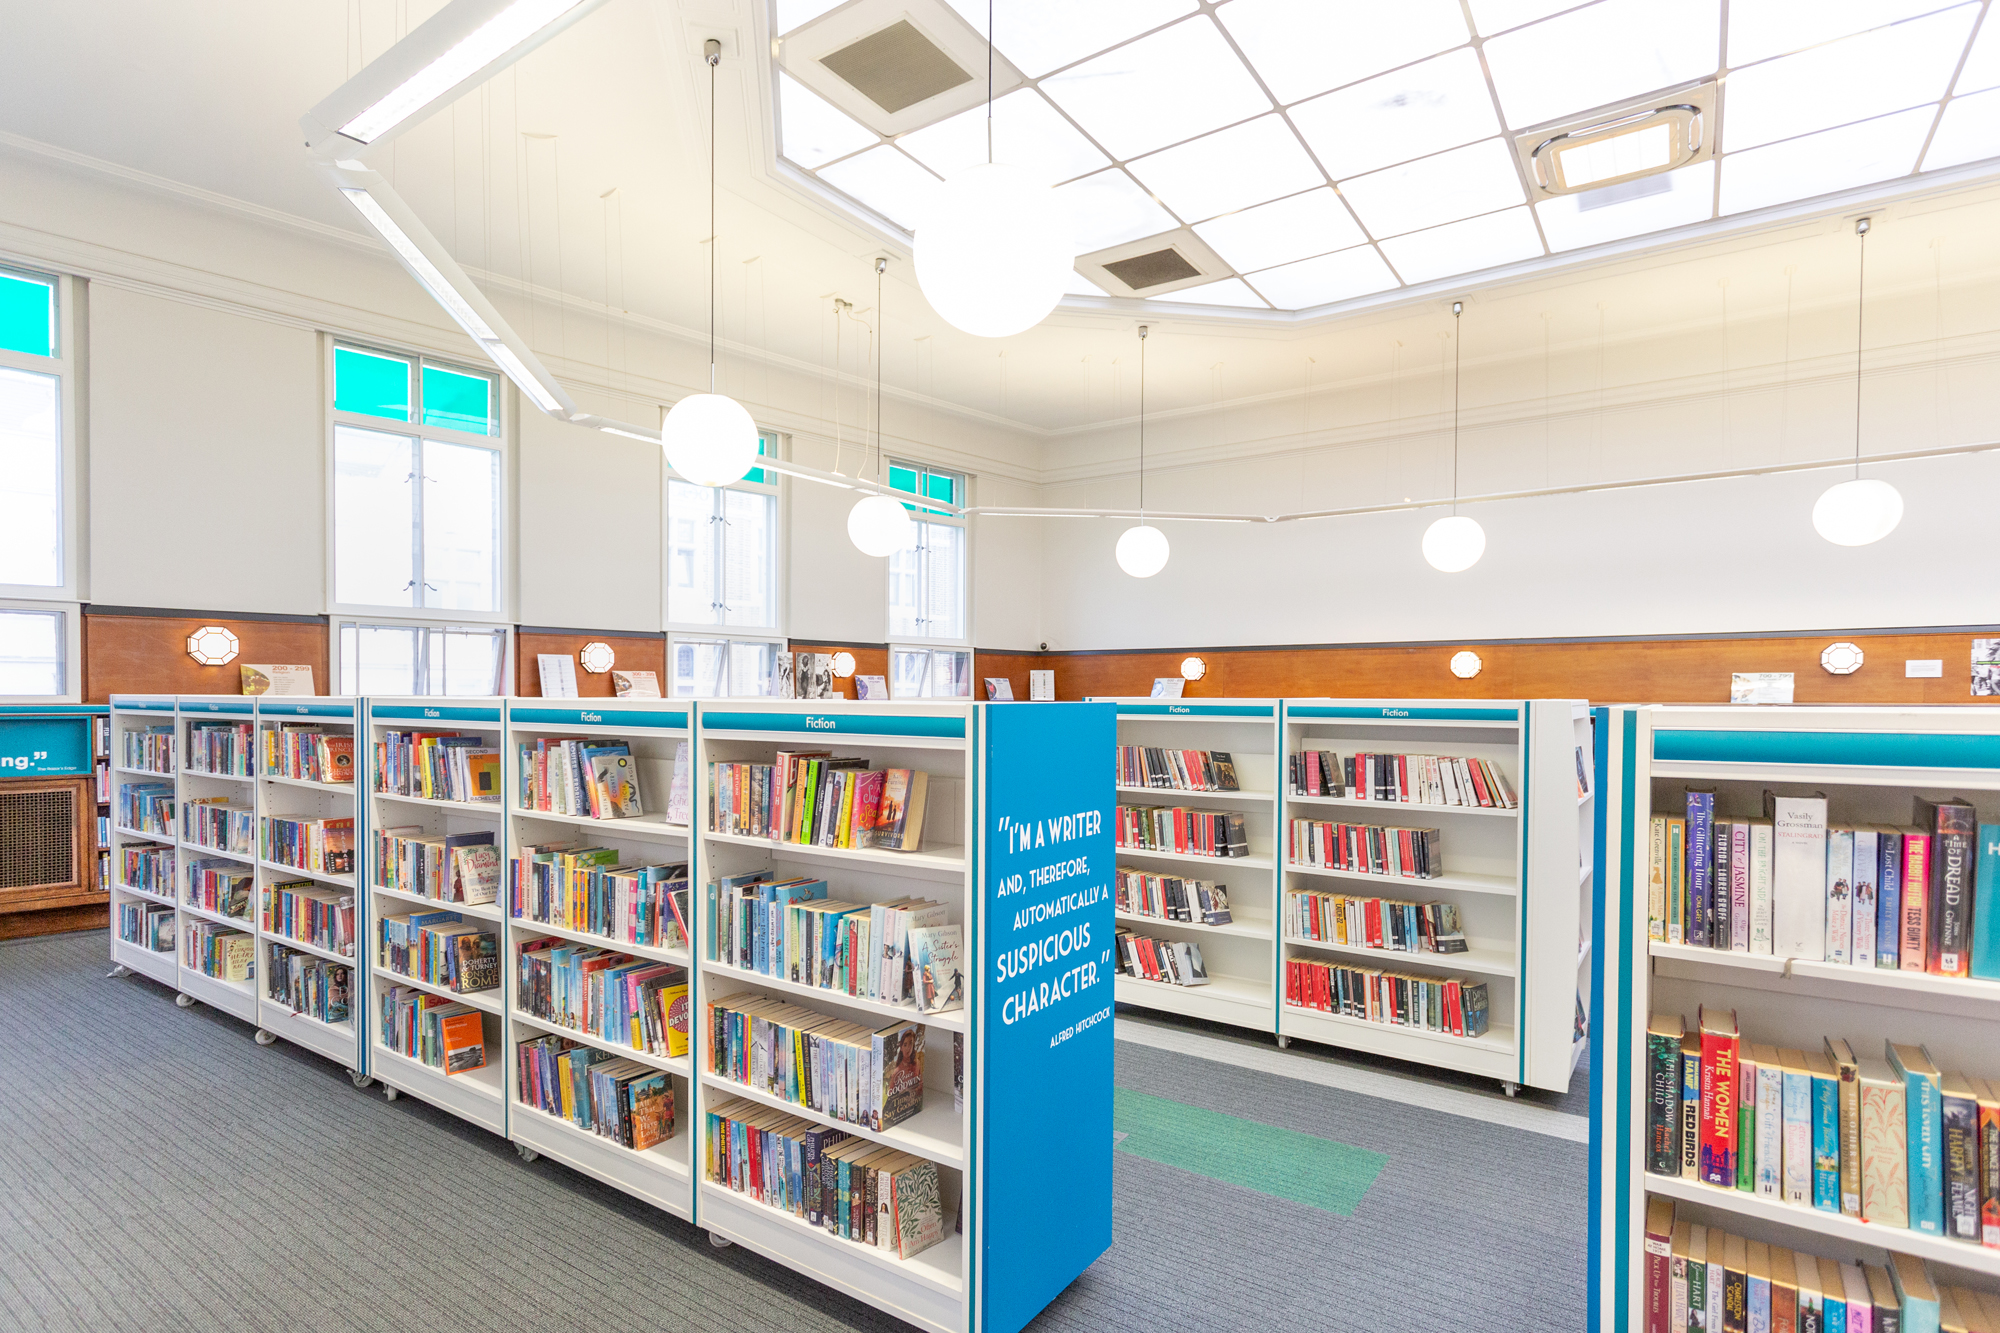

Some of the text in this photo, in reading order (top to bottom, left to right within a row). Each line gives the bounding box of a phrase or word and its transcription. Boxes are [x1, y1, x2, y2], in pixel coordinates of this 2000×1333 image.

[424, 708, 440, 717] Fiction
[580, 712, 602, 722] Fiction
[806, 717, 836, 729] Fiction
[1382, 708, 1409, 718] Fiction
[570, 742, 578, 768] LOUISE
[774, 756, 784, 806] BOOTH
[621, 784, 630, 810] PATRICIA
[795, 783, 804, 808] Orange
[842, 774, 852, 824] KATERINA
[1696, 811, 1706, 826] The
[1777, 820, 1823, 828] Grossman
[1787, 812, 1814, 822] Vasily
[874, 830, 904, 839] SURVIVORS
[1034, 820, 1045, 850] A
[1048, 810, 1102, 845] WRITER
[1758, 833, 1766, 844] ON
[1652, 823, 1662, 865] Kate Grenville
[1694, 828, 1705, 867] Glittering
[1734, 831, 1746, 856] CITY
[1758, 846, 1766, 857] THE
[1943, 840, 1968, 848] TIME
[466, 858, 499, 872] Diamond
[474, 852, 490, 862] Lucy
[1884, 850, 1894, 867] Lost
[998, 856, 1091, 898] AND, THEREFORE,
[1695, 868, 1704, 890] Hour
[1718, 834, 1727, 920] FLORIDA LAUREN GROFF
[1758, 860, 1766, 884] BRIGHT
[1884, 868, 1894, 890] Child
[1944, 856, 1962, 906] DREAD
[1734, 866, 1744, 908] JASMINE
[1758, 887, 1766, 902] SIDE
[1906, 840, 1924, 952] THE RABBIT HUTCH TESS GUNTY
[926, 910, 946, 918] Gibson
[1013, 883, 1109, 931] AUTOMATICALLY A
[422, 915, 458, 926] MARGARET
[1854, 916, 1862, 935] Victory
[922, 939, 958, 952] A Sister's
[997, 922, 1091, 983] SUSPICIOUS
[462, 956, 496, 966] DOHERTY
[471, 962, 498, 970] TURNEY
[928, 950, 958, 966] Struggle
[461, 968, 498, 979] SONS OF
[462, 975, 498, 989] ROME
[1050, 1006, 1111, 1048] ALFRED HITCHCOCK
[887, 1074, 921, 1096] GOODWIN
[1685, 1060, 1694, 1090] HANIF
[1655, 1072, 1664, 1104] CHILD
[1665, 1058, 1675, 1123] THE SHADOW
[1703, 1064, 1714, 1120] Kristin Hannah
[1714, 1048, 1732, 1138] THE WOMEN
[1922, 1081, 1930, 1106] THIS
[638, 1105, 656, 1114] That
[639, 1100, 650, 1108] All
[884, 1110, 896, 1120] Say
[640, 1114, 651, 1123] We
[640, 1120, 658, 1131] Have
[1922, 1108, 1931, 1142] LOVELY
[641, 1128, 658, 1138] Lost
[1656, 1124, 1664, 1153] Hancox
[1664, 1128, 1672, 1152] Rachel
[1686, 1104, 1696, 1167] RED BIRDS
[1788, 1124, 1797, 1160] Daughters
[1849, 1122, 1857, 1156] OTHER
[1922, 1145, 1931, 1168] CITY
[1989, 1129, 1998, 1188] THE DANCE TREE
[910, 1236, 920, 1247] Am
[920, 1229, 940, 1244] Happy
[920, 1222, 937, 1234] Often
[1692, 1280, 1702, 1308] HART
